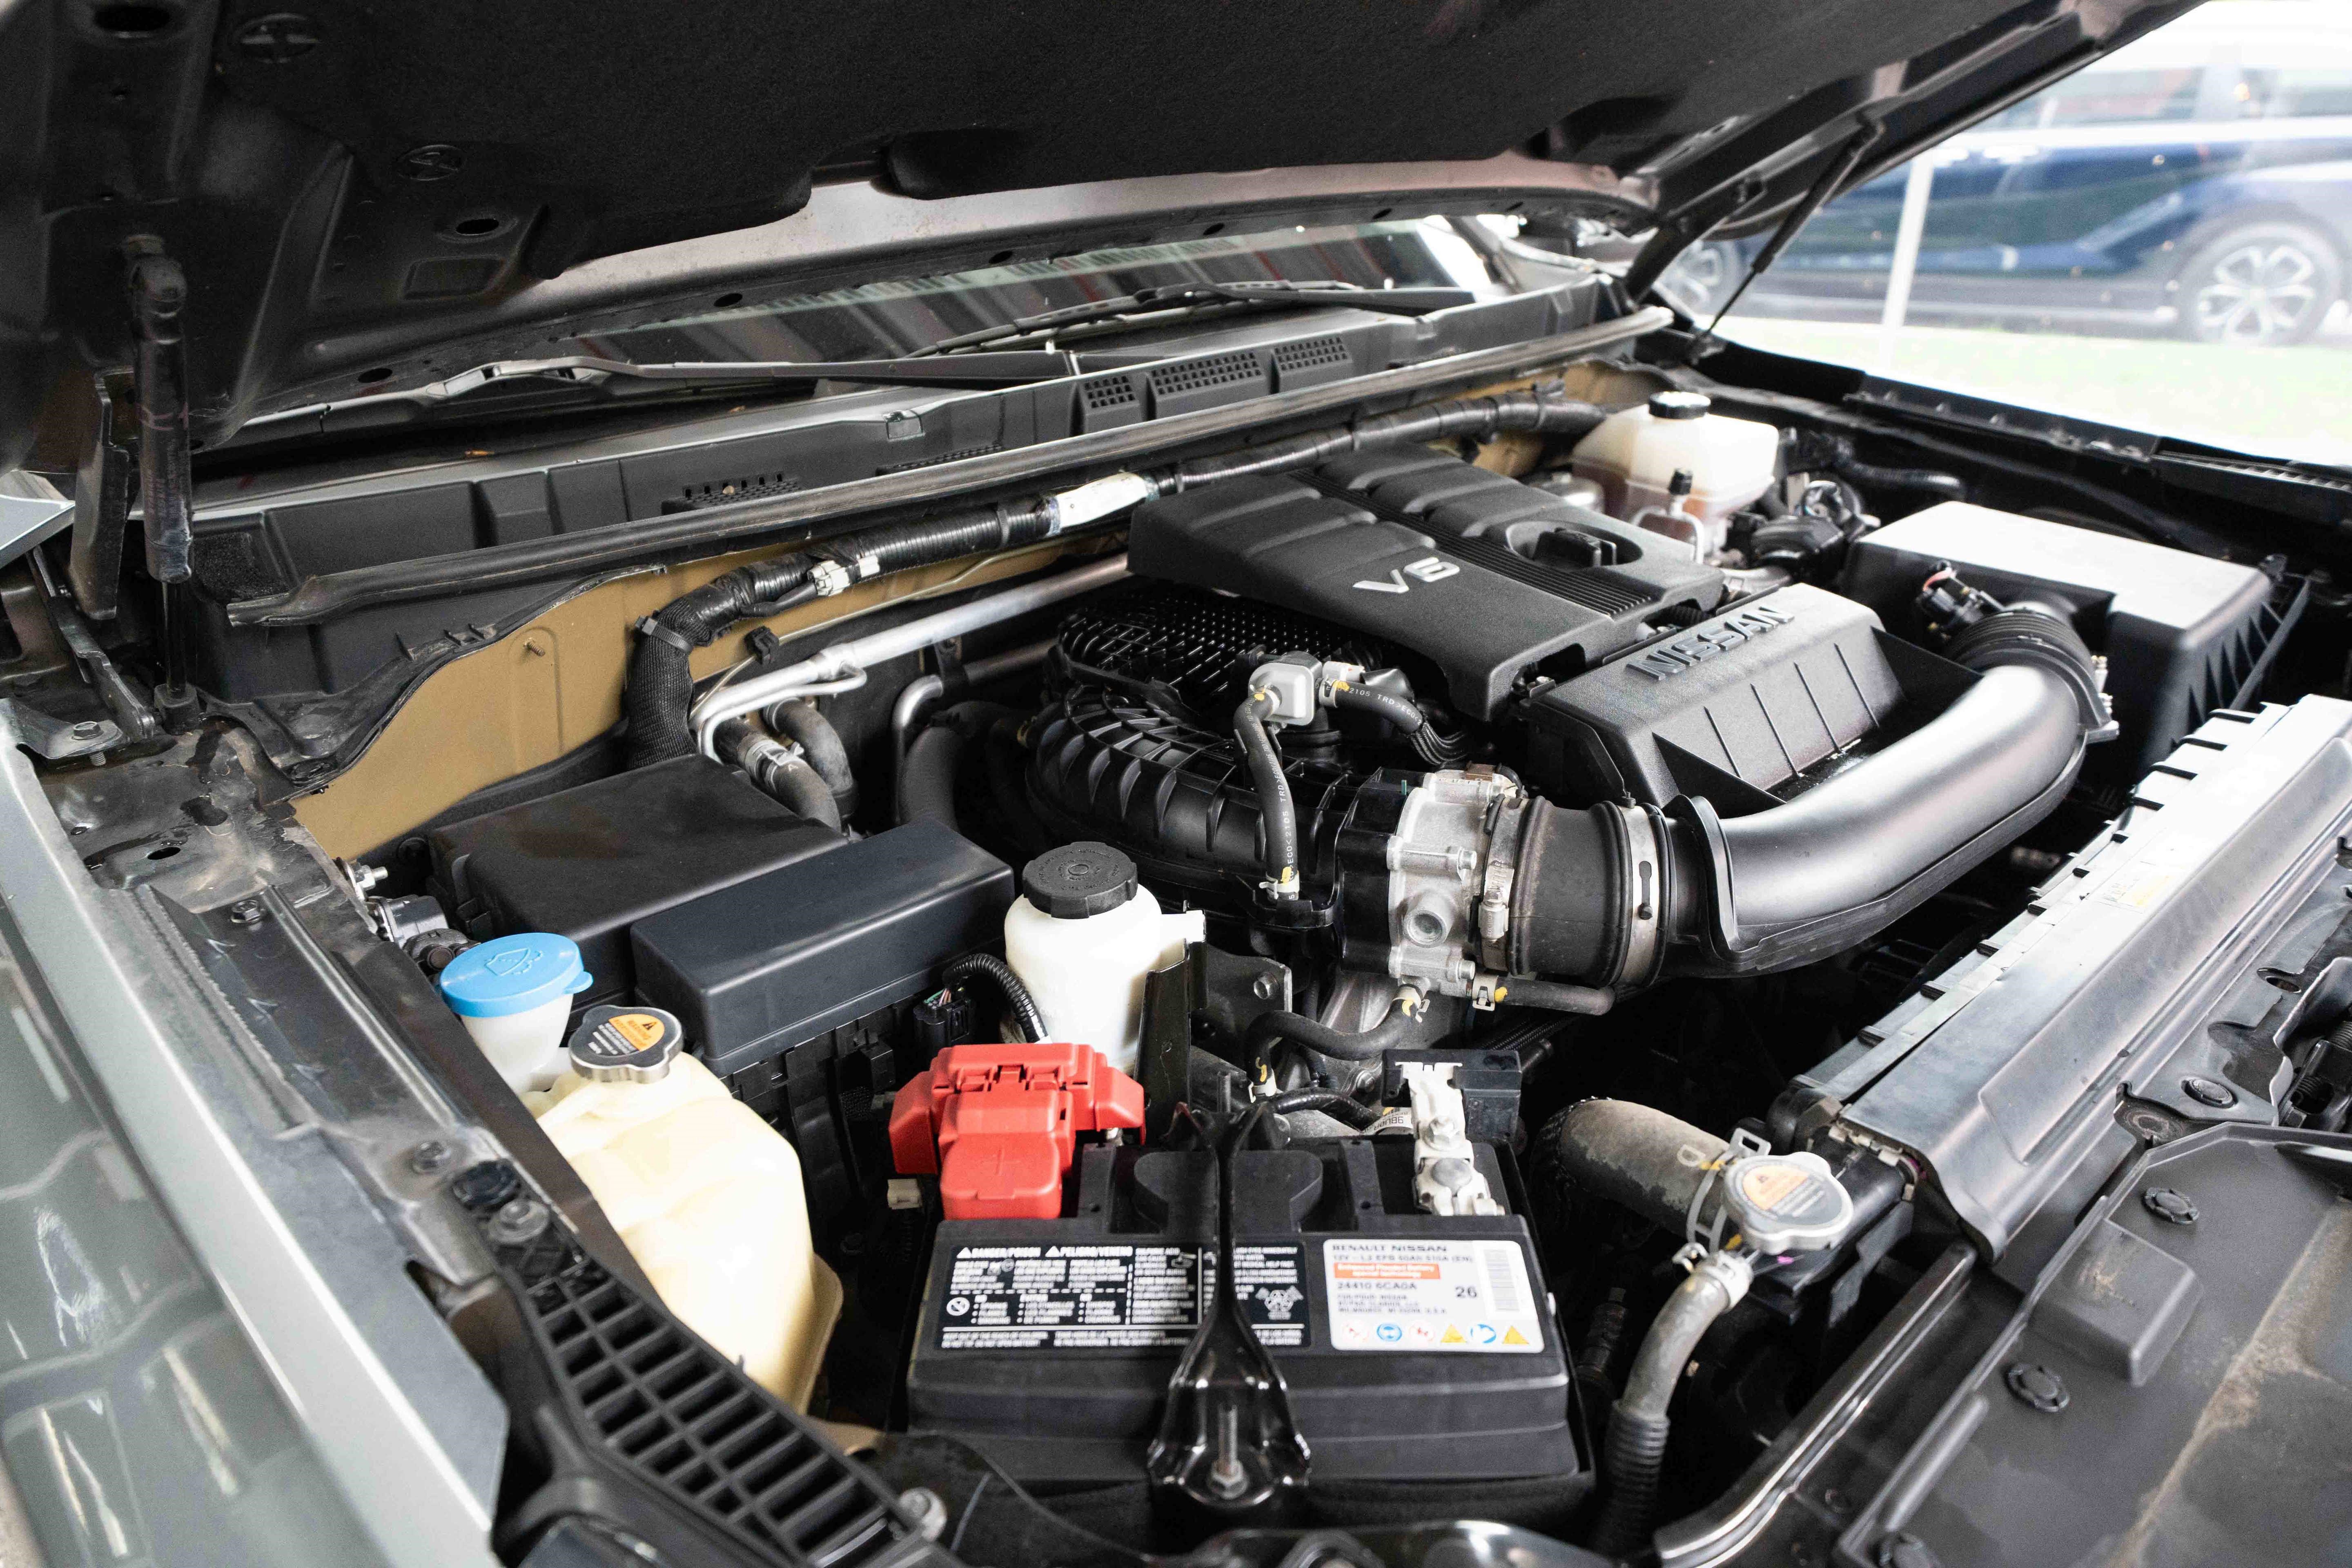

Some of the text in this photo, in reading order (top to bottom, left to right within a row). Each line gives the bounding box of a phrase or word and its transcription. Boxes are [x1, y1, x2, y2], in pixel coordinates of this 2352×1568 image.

[1352, 557, 1460, 594] V6
[1626, 606, 1795, 681] NISSAN
[1454, 1286, 1478, 1299] 26
